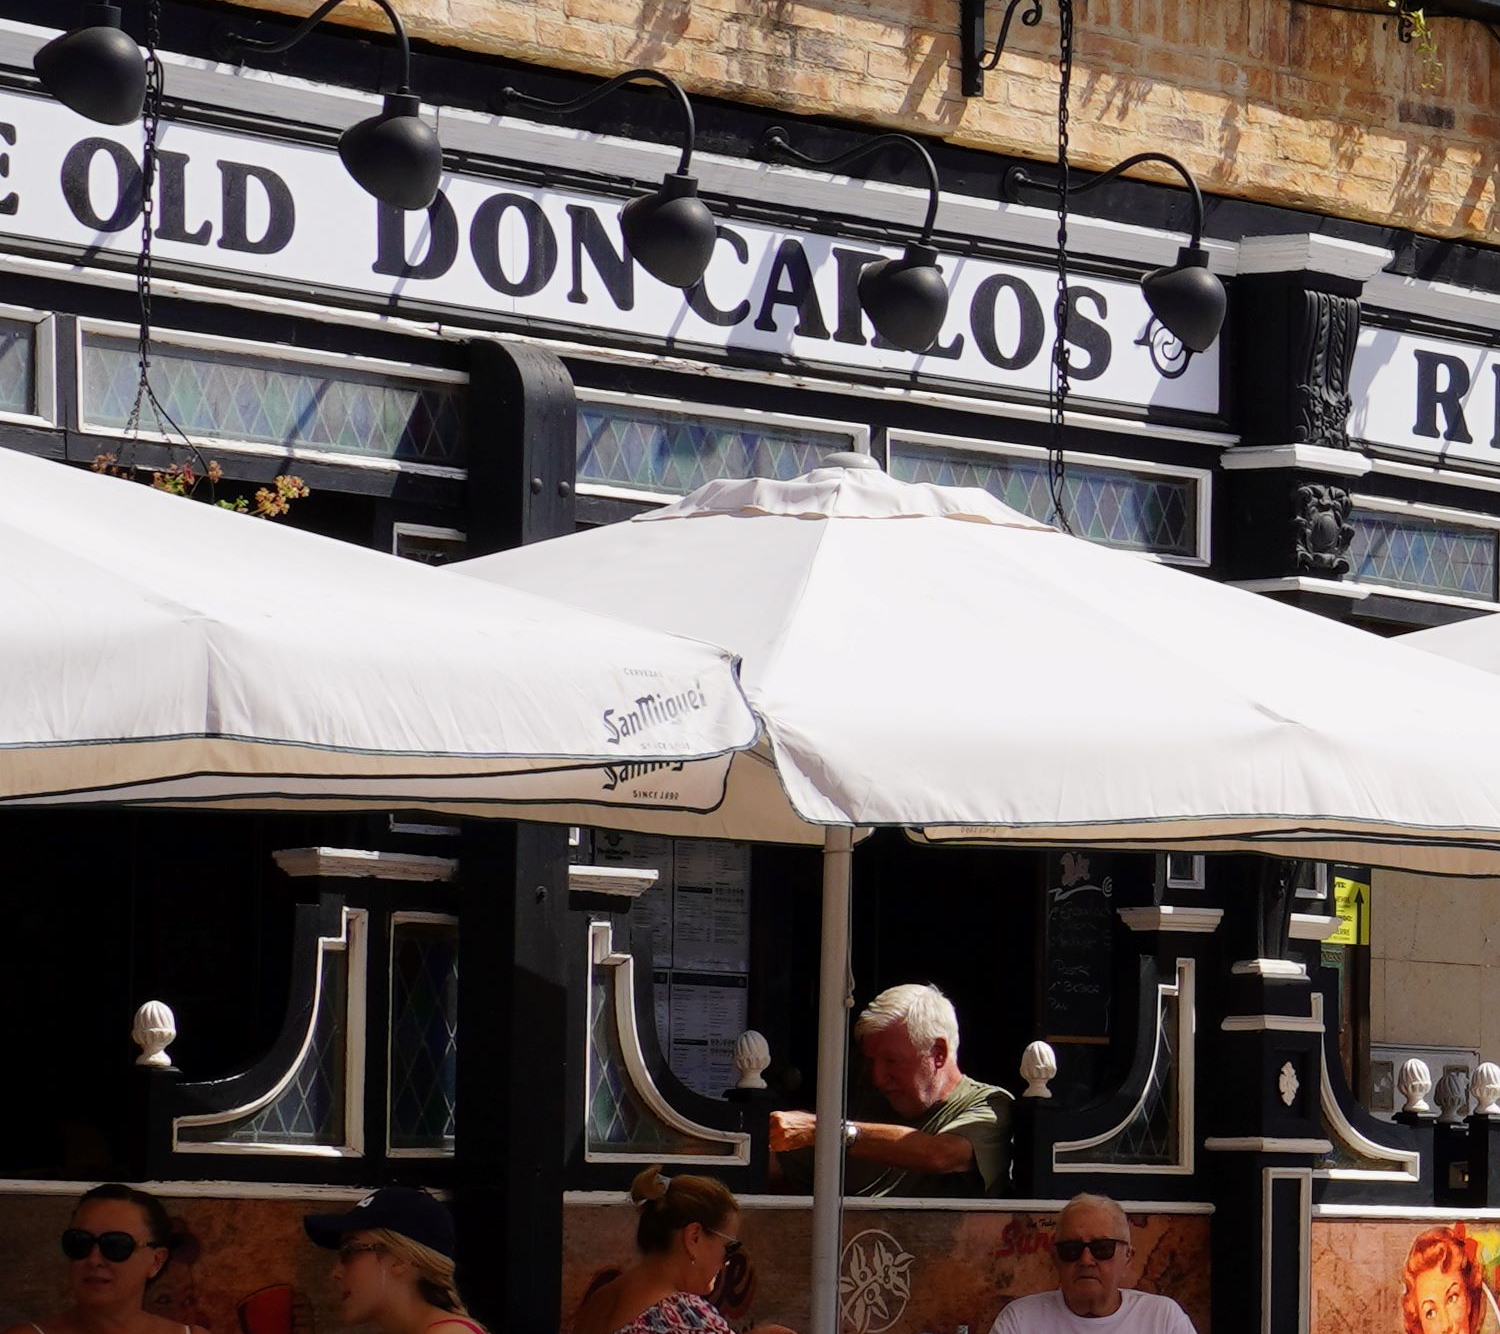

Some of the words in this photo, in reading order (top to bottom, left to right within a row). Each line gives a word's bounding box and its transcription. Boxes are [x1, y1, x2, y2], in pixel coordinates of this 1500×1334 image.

[59, 135, 296, 257] OLD
[372, 188, 636, 313] DON
[684, 225, 1112, 381] CAOS
